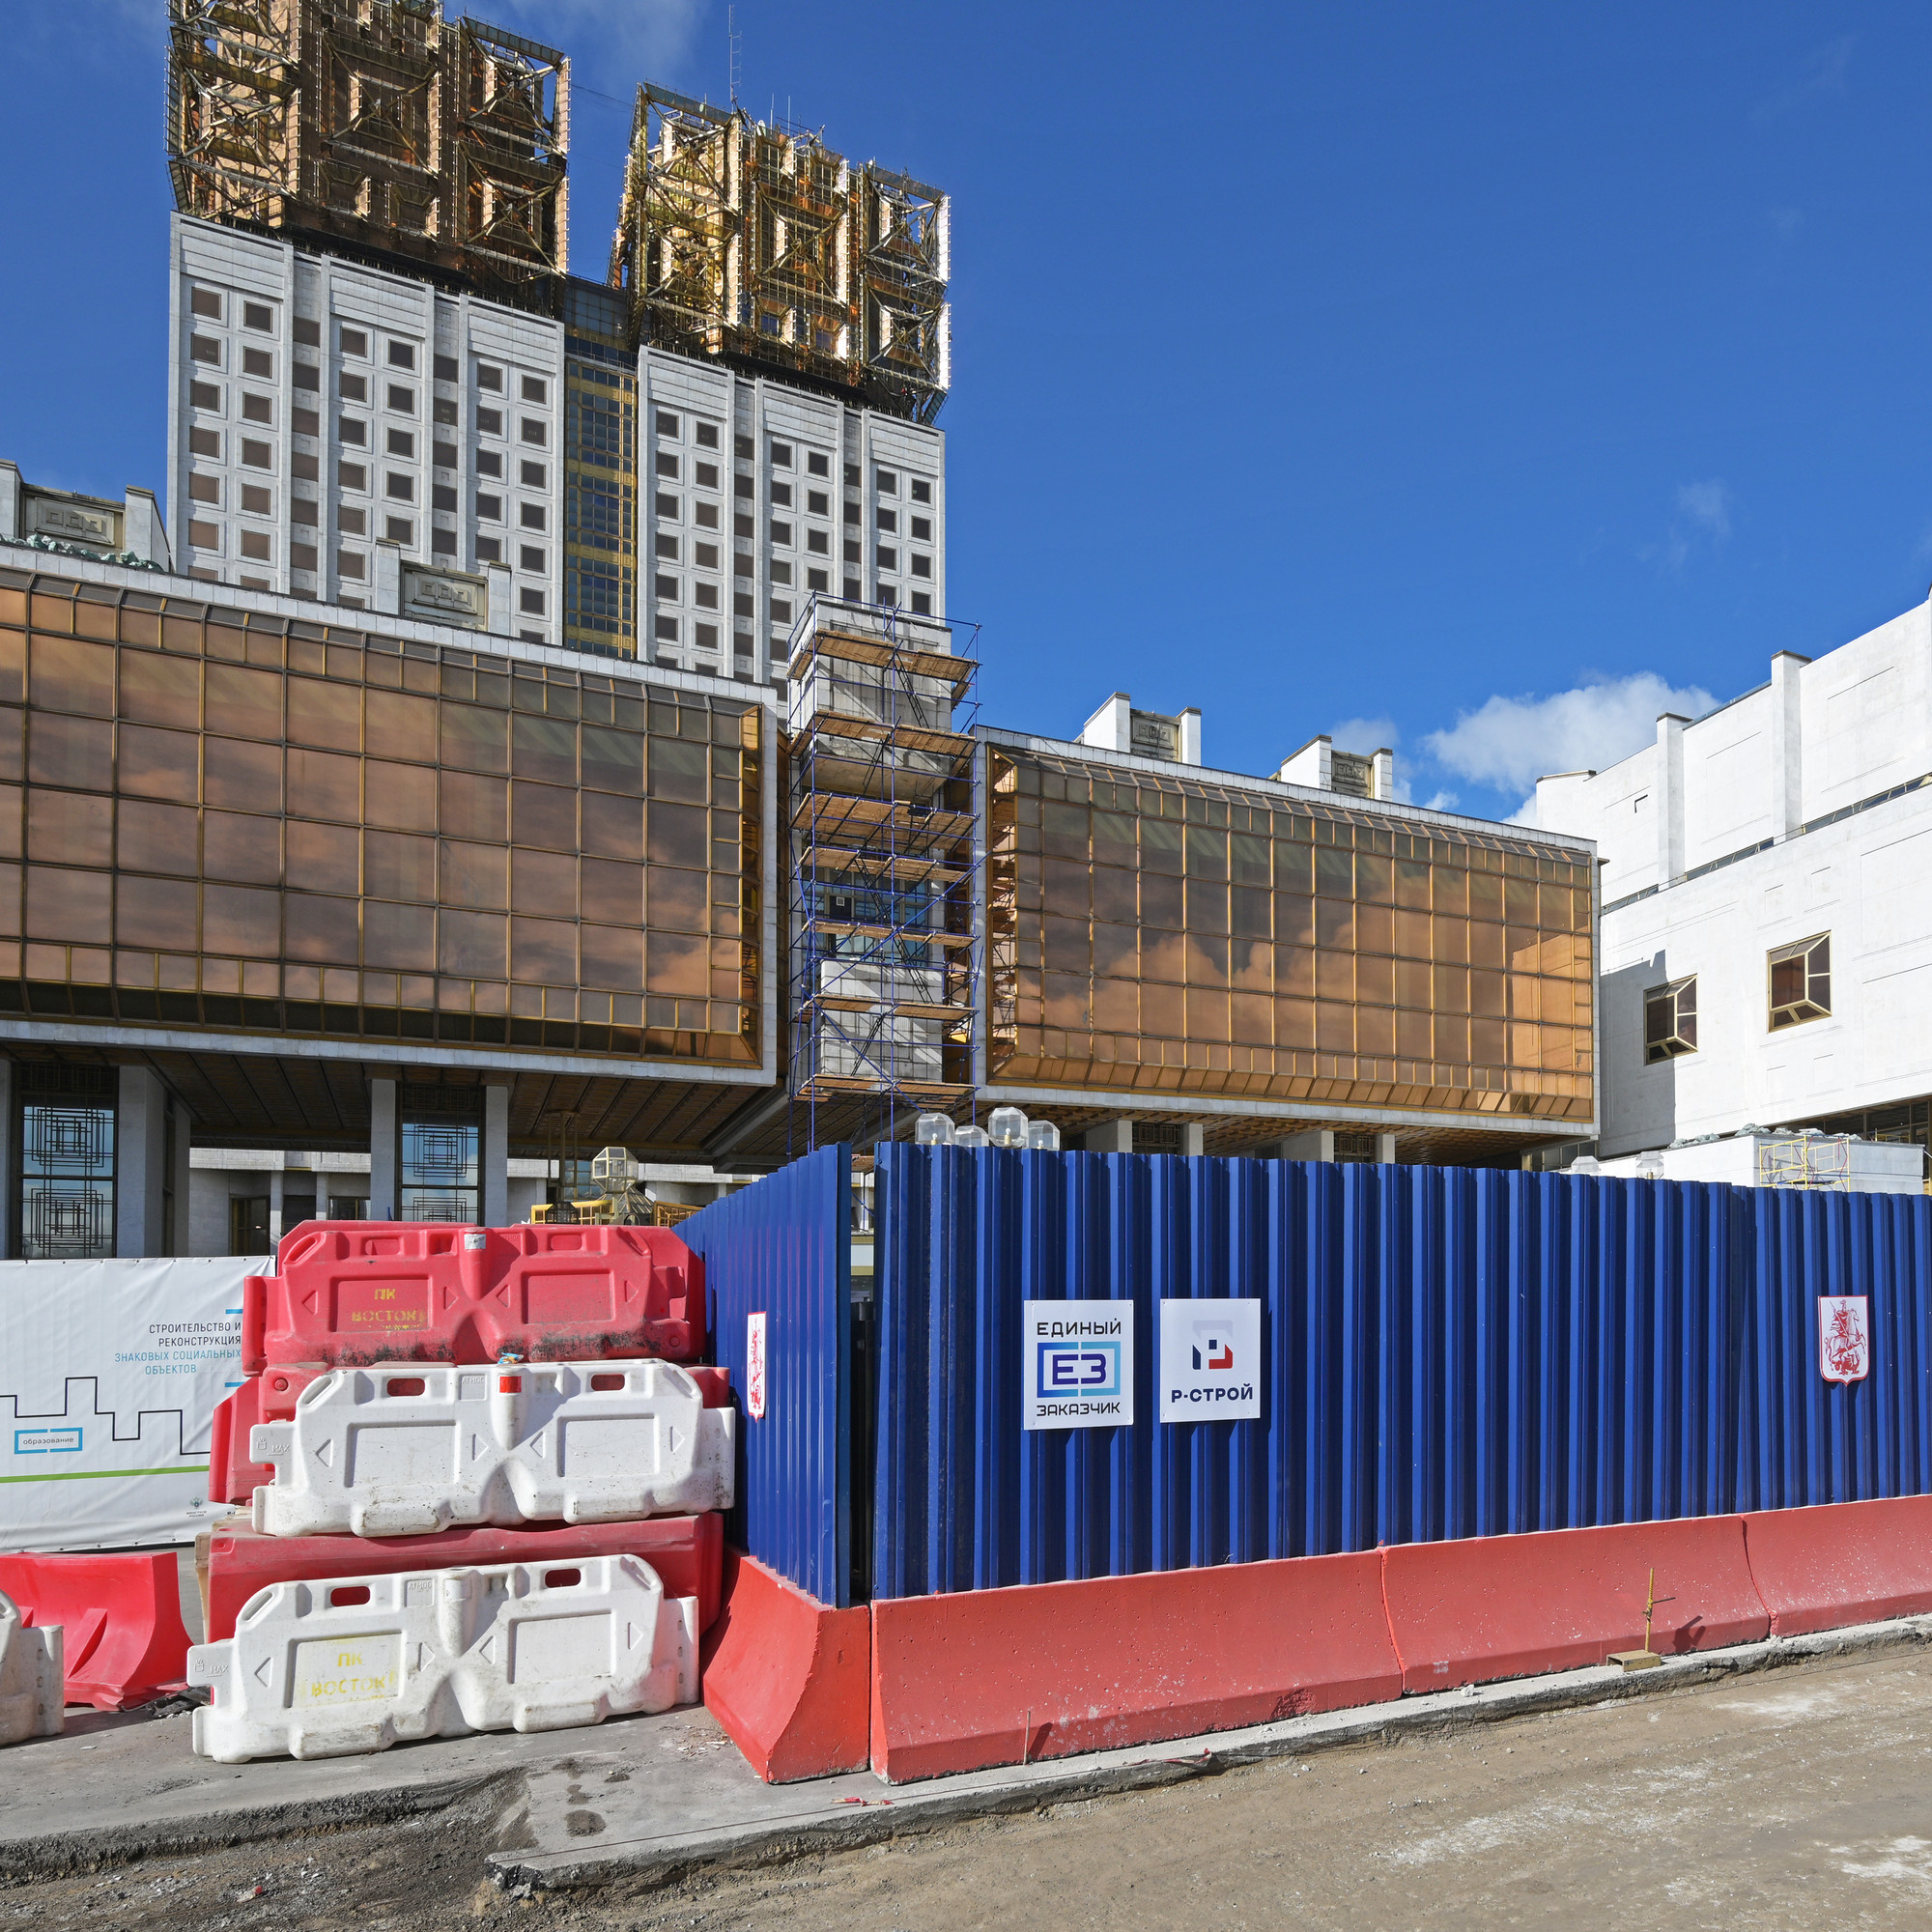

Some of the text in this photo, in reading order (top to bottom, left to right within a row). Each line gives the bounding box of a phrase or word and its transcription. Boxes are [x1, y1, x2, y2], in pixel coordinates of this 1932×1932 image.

[149, 1321, 242, 1333] СТРОИТЕЛЬСТВО И
[1037, 1318, 1122, 1337] ЕДИНЫЙ
[158, 1335, 242, 1347] РЕКОНСТРУКЦИЯ
[115, 1349, 242, 1362] ЗНАКОВЫХ СОЦИАЛЬНЫХ
[145, 1364, 197, 1375] ОБЪЕКТОВ
[1171, 1383, 1253, 1403] Р-СТРОЙ
[1037, 1402, 1121, 1416] ЗАКАЗЧИК
[337, 1652, 362, 1667] ПК
[311, 1676, 386, 1697] ВОСТОК
